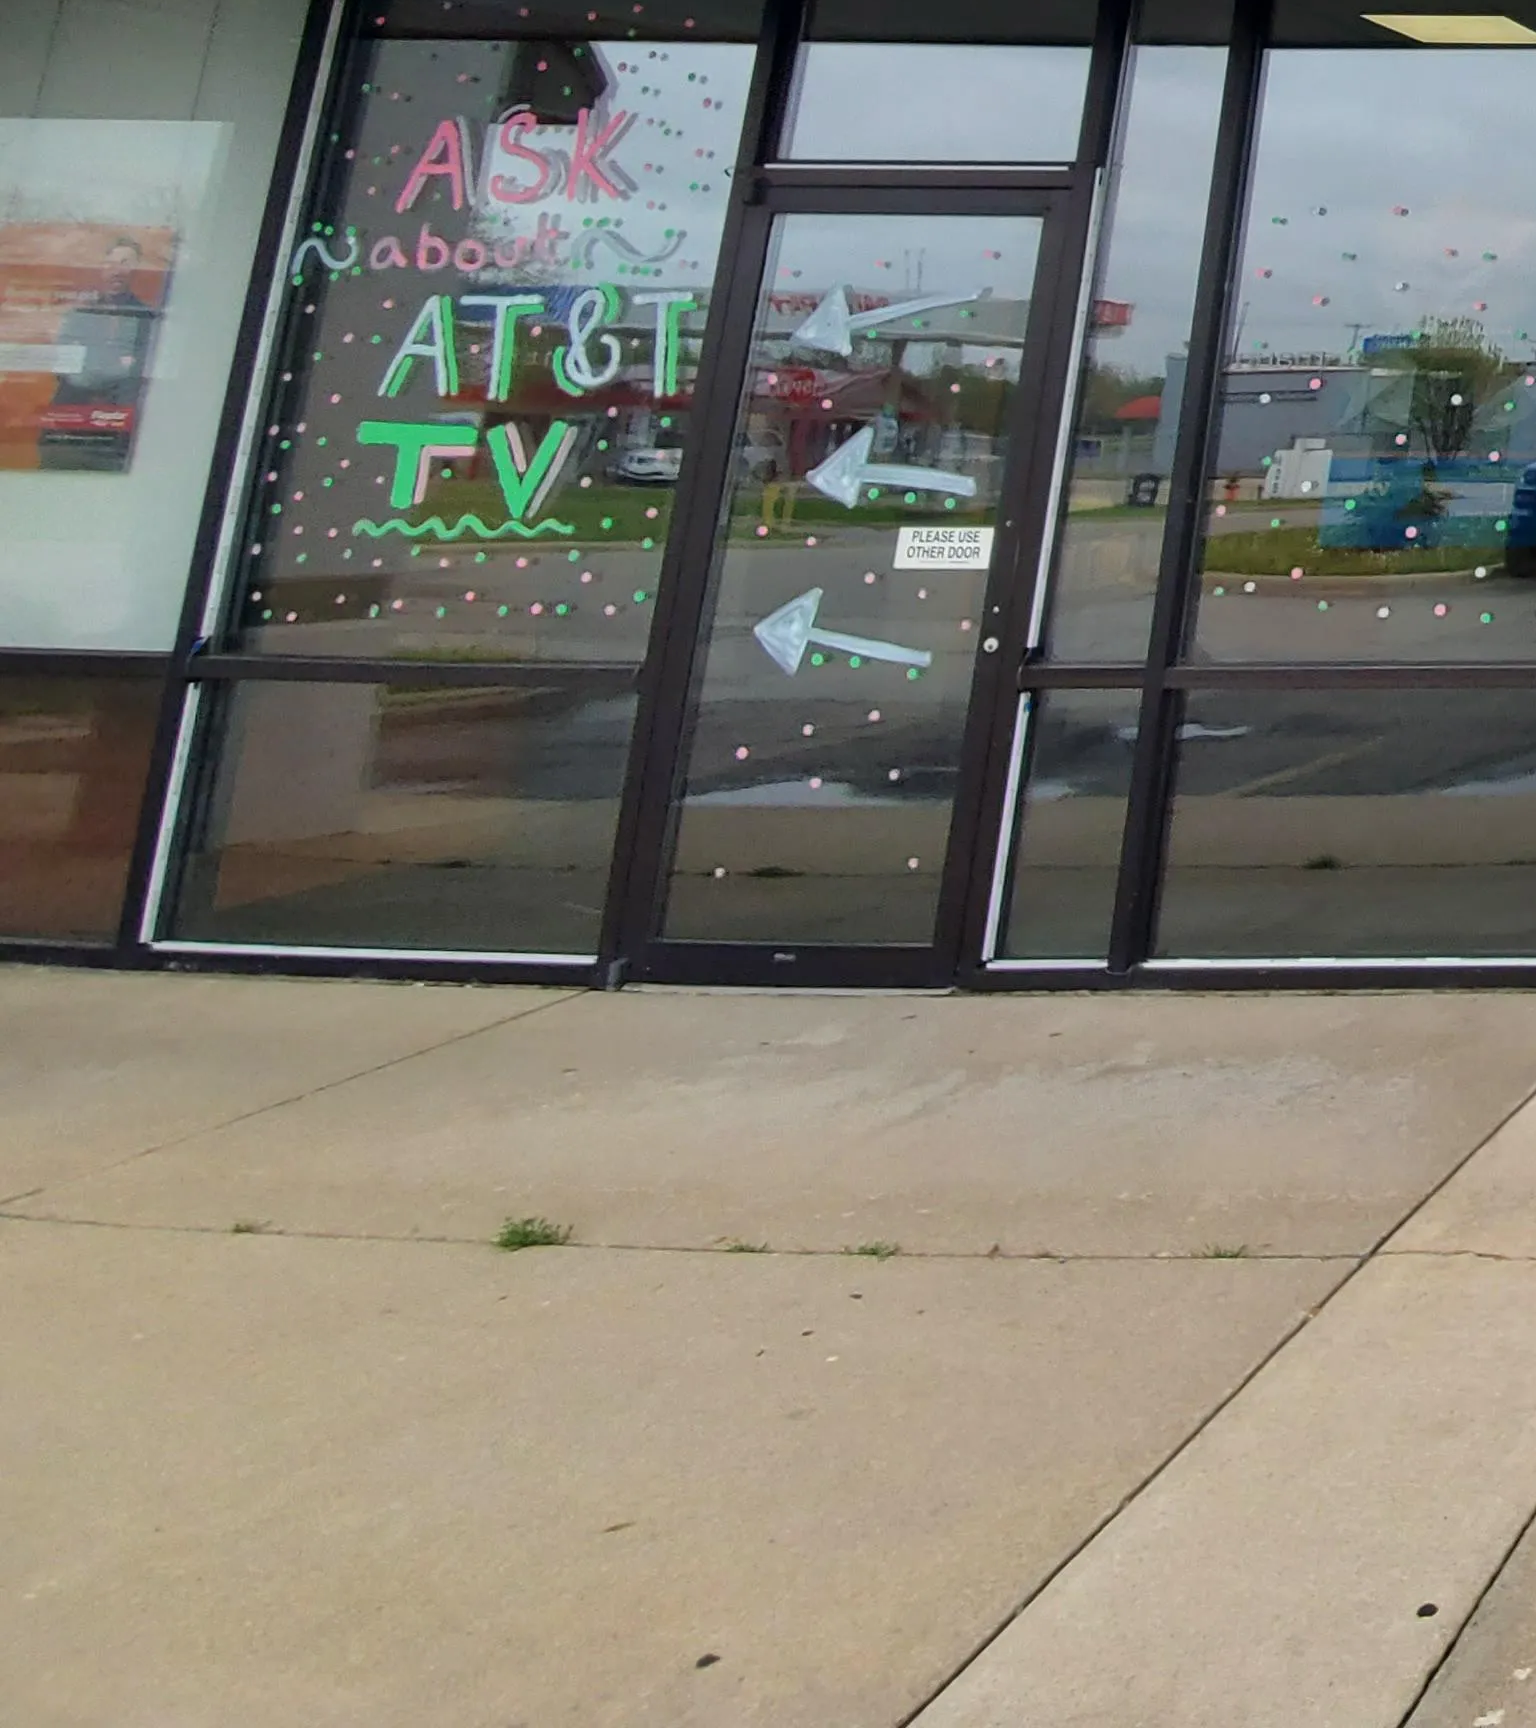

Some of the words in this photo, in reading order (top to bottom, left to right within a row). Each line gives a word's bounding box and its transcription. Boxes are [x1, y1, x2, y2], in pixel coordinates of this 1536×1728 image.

[394, 105, 634, 213] ASK
[370, 212, 567, 272] about
[377, 283, 697, 399] AT&T
[357, 420, 577, 518] TV
[906, 546, 945, 559] OTHER
[947, 546, 981, 559] DOOR
[911, 530, 956, 543] PLEASE
[958, 530, 981, 543] USE
